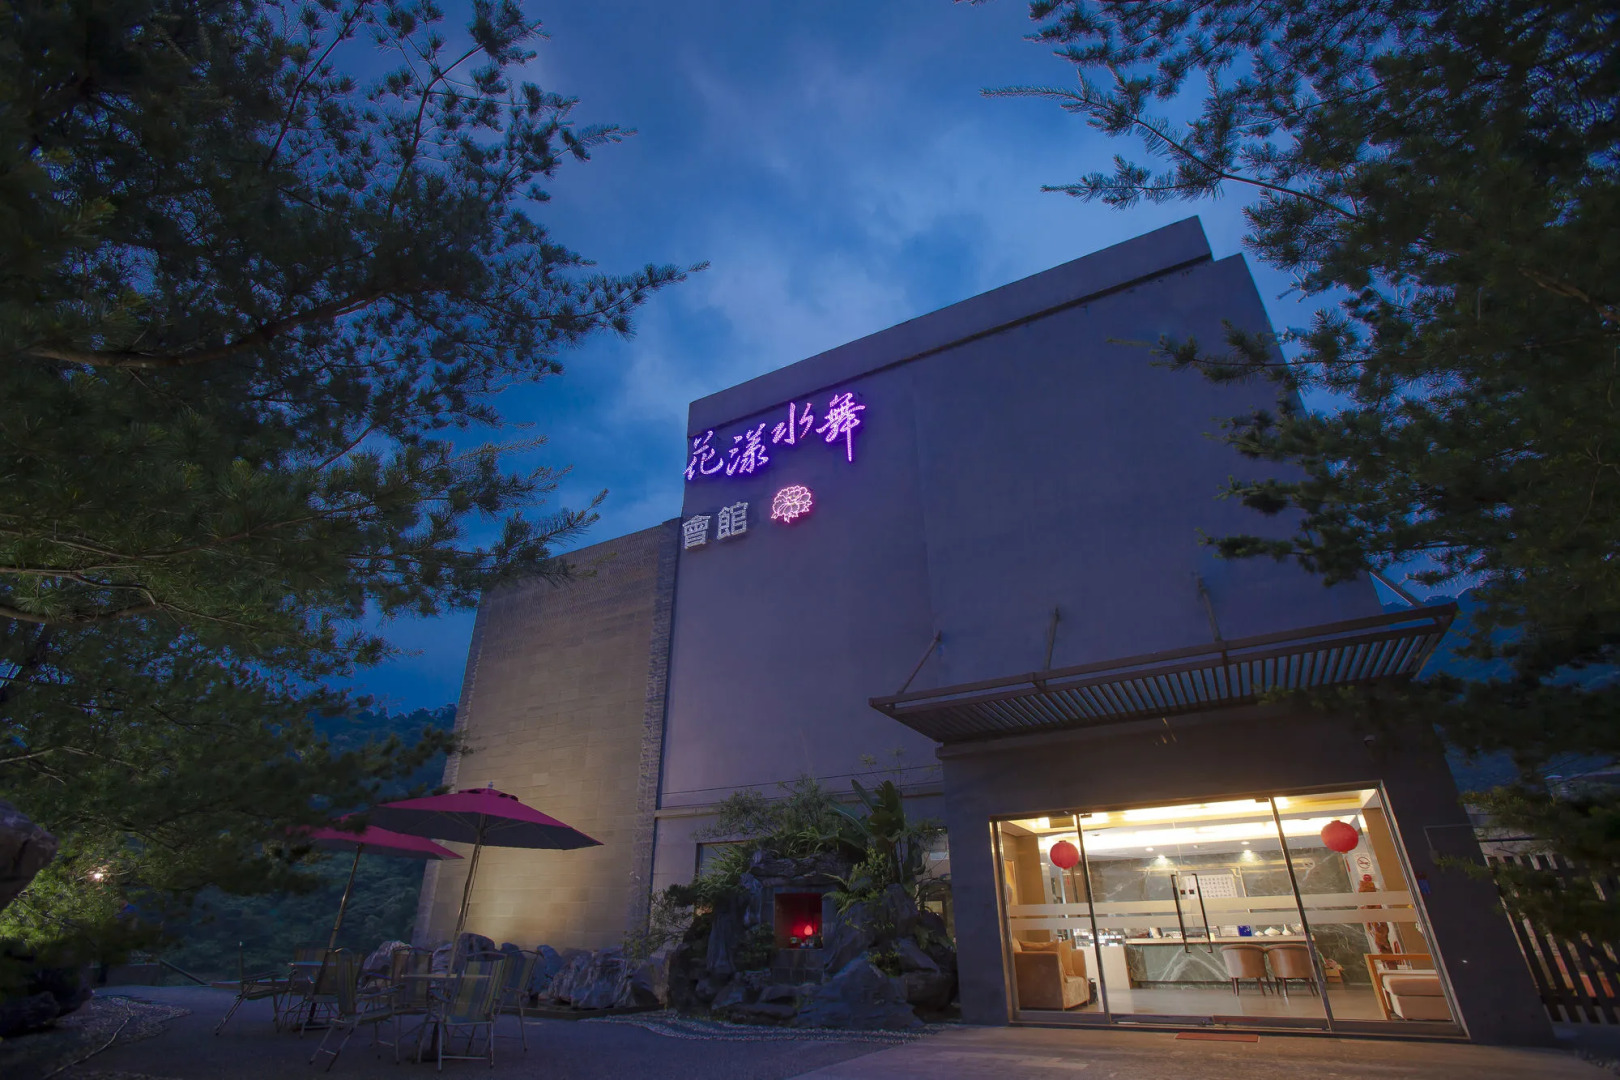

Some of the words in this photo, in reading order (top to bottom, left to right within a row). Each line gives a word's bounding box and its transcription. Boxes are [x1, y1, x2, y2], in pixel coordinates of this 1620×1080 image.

[683, 392, 866, 480] 花漾水舞
[682, 501, 748, 550] 會館
